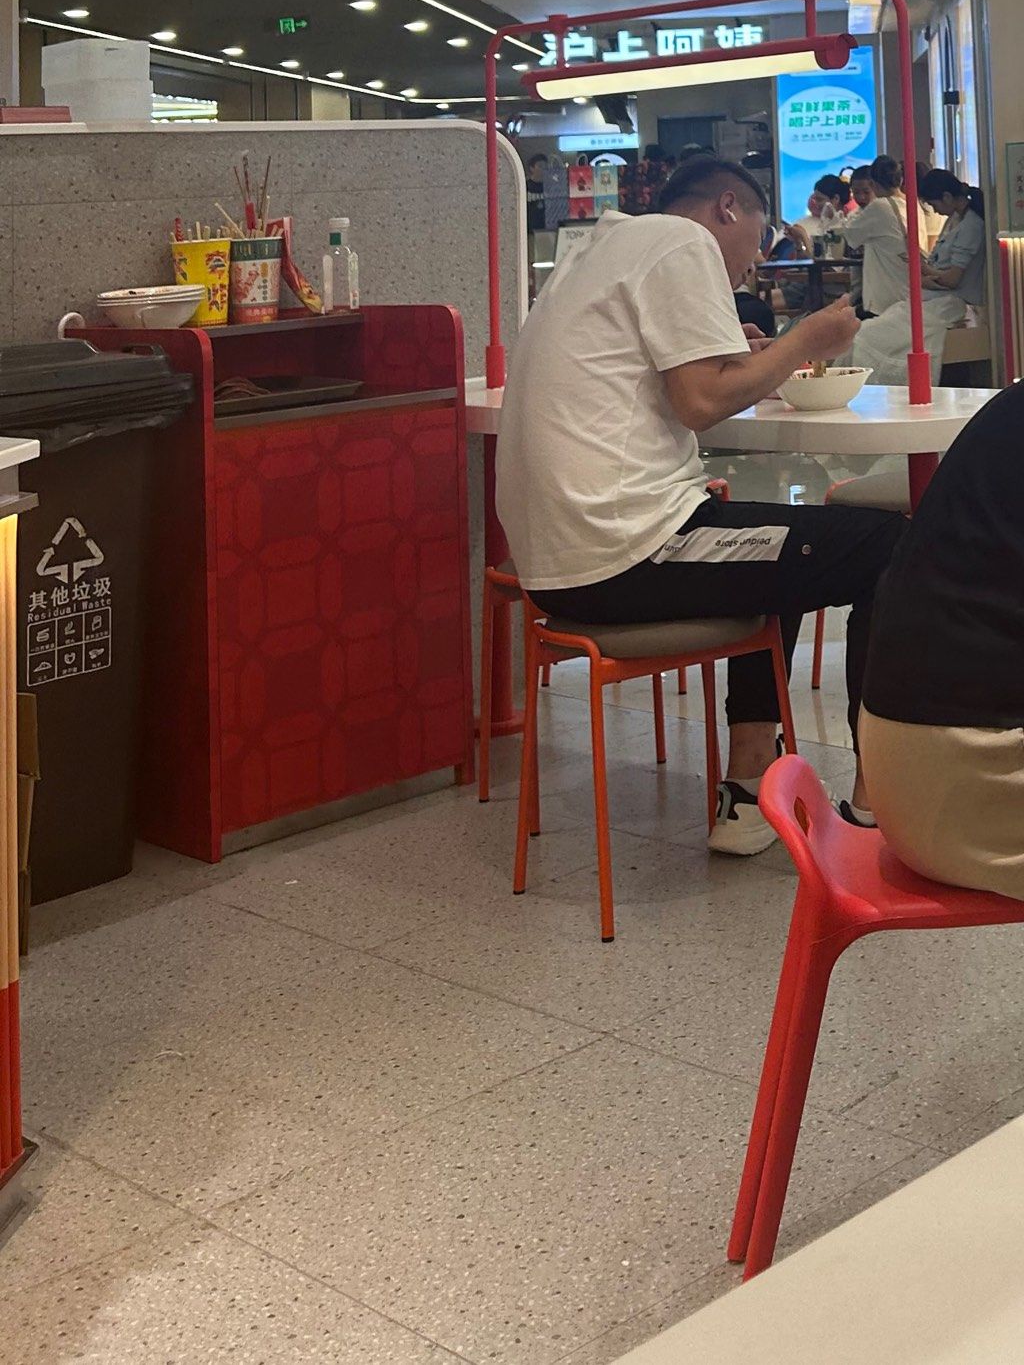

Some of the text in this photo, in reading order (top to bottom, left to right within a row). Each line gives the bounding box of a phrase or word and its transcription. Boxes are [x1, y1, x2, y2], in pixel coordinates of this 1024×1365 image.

[715, 540, 738, 548] store
[29, 577, 111, 612] 其他垃圾
[28, 598, 111, 623] Residual Waste
